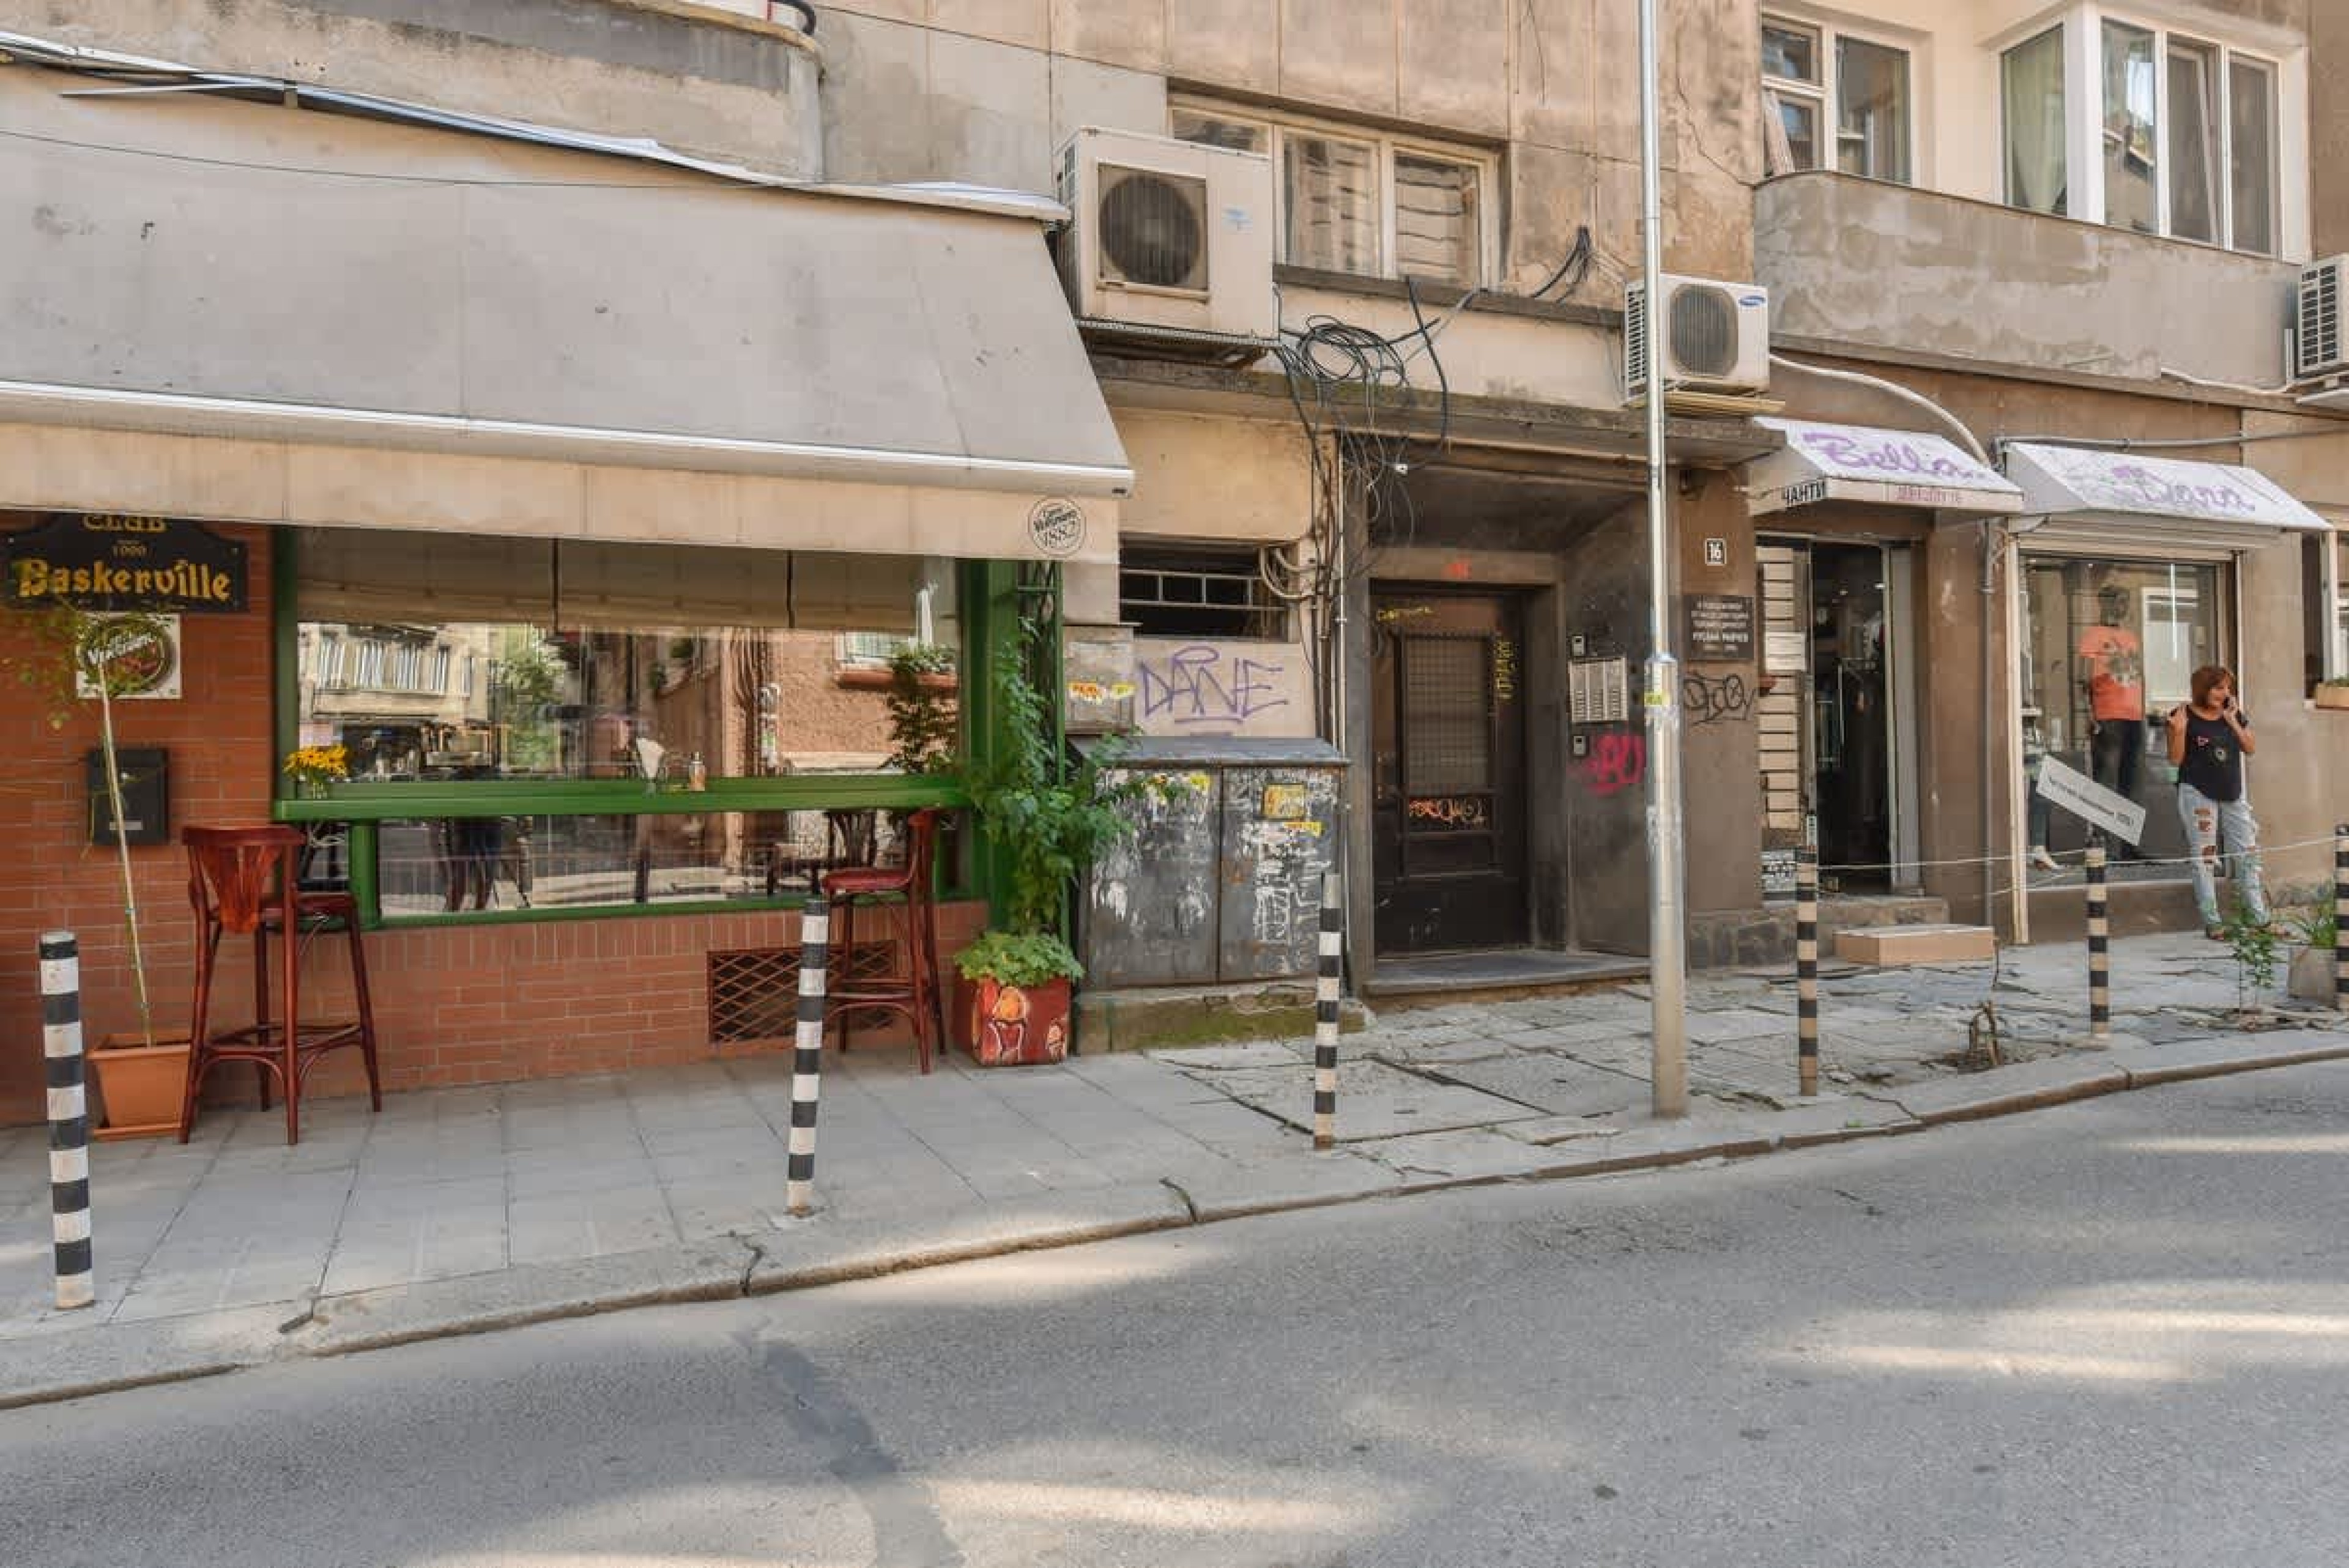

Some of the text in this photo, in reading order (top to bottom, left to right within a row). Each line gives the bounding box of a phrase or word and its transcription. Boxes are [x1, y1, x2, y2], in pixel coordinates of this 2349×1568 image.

[1803, 432, 1973, 477] Bella
[1709, 543, 1722, 560] 16
[18, 559, 232, 601] Baskerville
